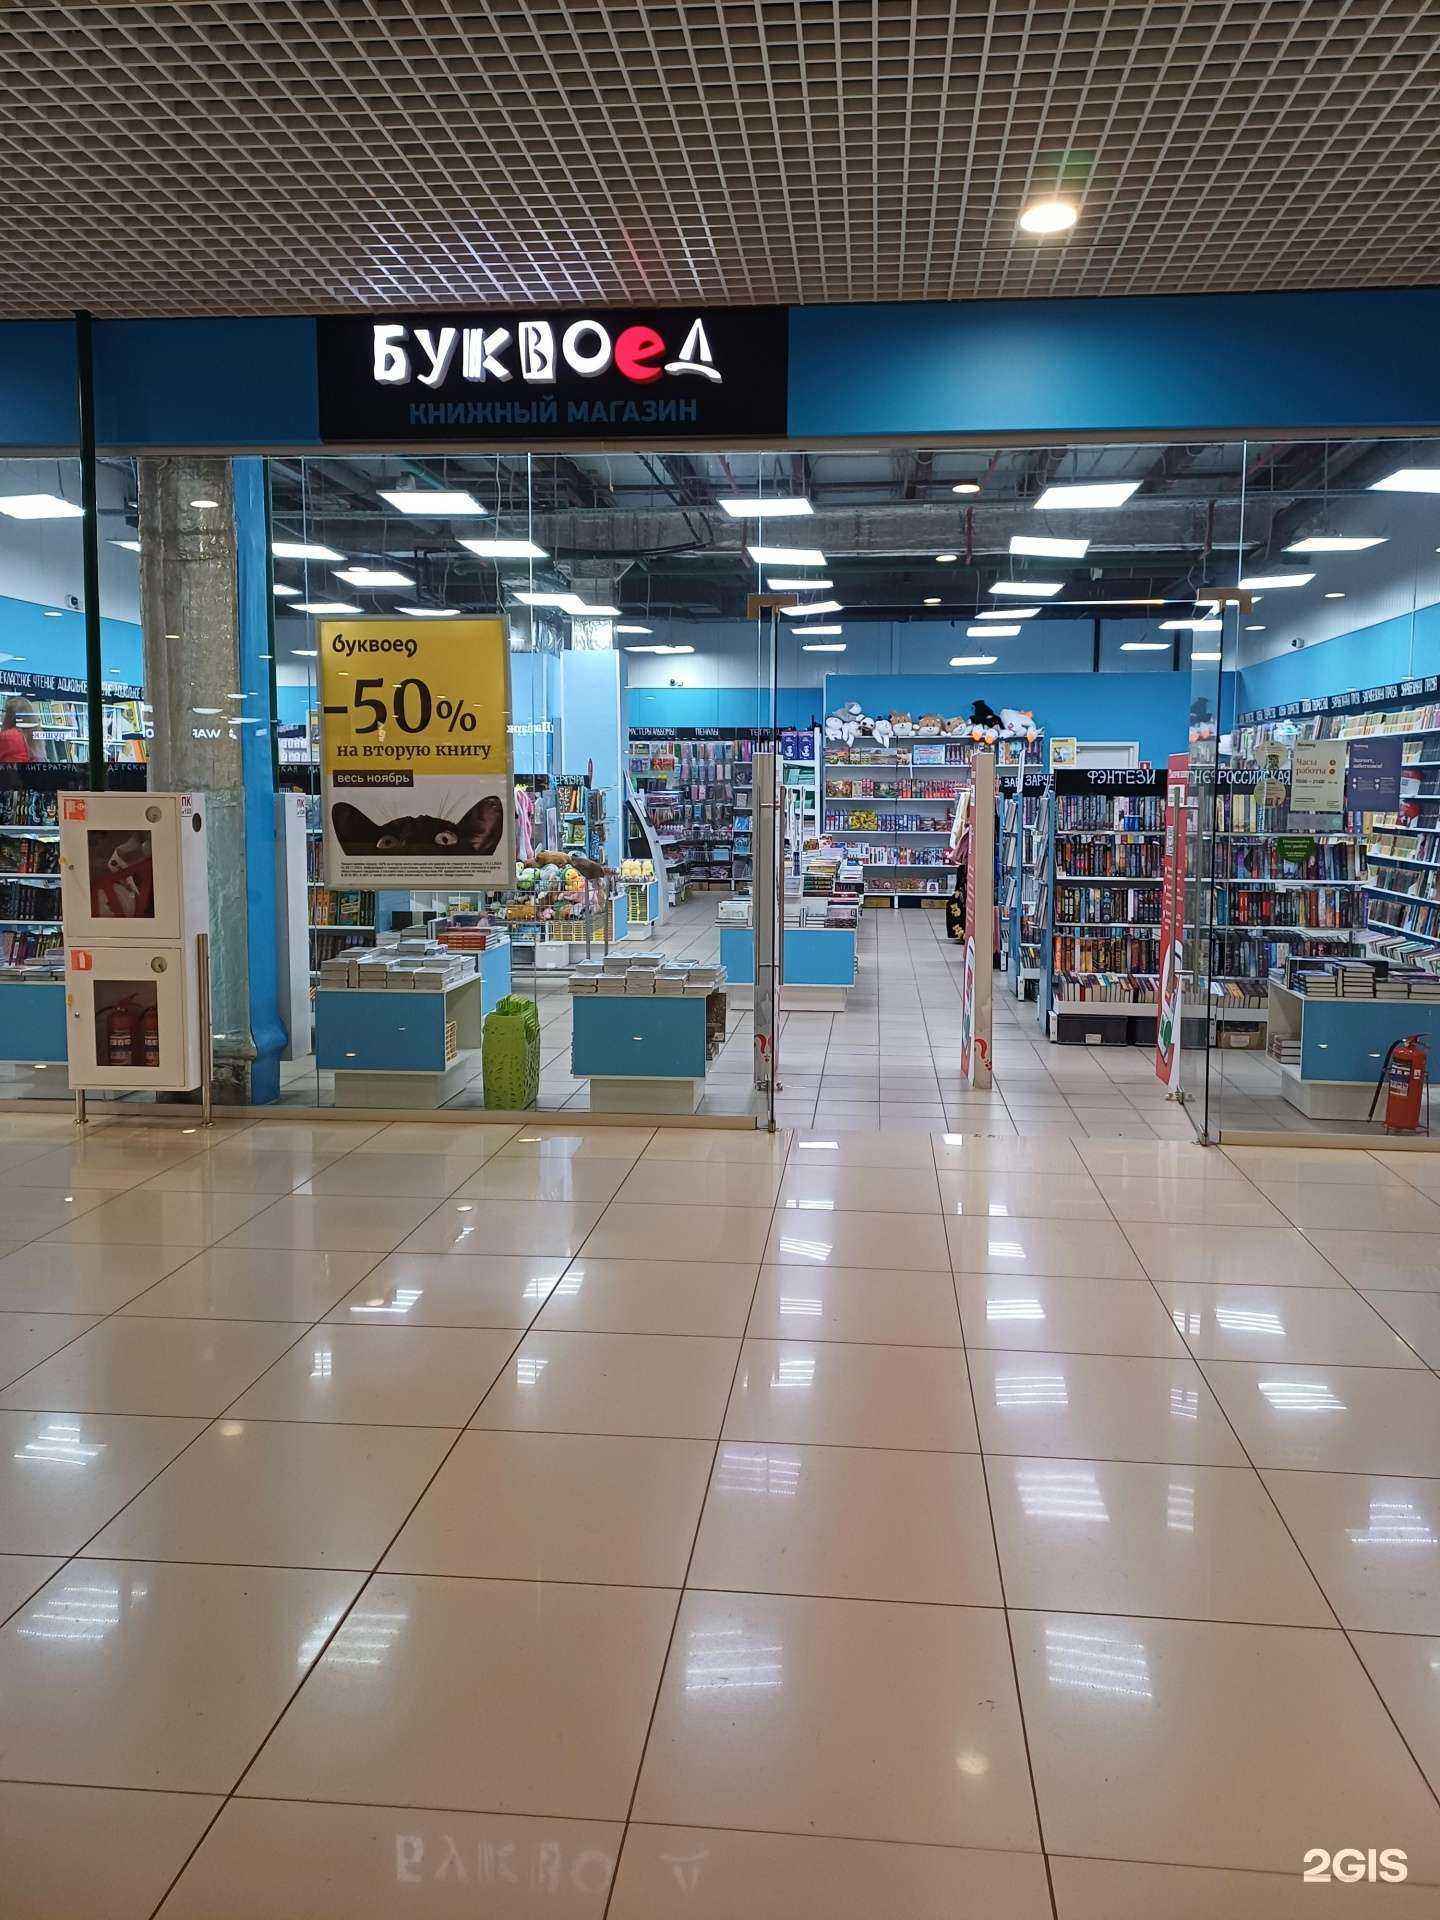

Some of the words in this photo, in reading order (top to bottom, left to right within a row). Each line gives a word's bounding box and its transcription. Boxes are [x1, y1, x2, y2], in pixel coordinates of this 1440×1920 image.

[409, 394, 558, 425] КНИЖНЫЙ
[567, 398, 697, 424] МАГАЗИН
[332, 634, 418, 657] буквоед
[336, 744, 357, 757] на
[363, 743, 430, 760] вторую
[436, 743, 491, 761] книгу
[337, 774, 364, 784] весь
[367, 773, 410, 784] ноябрь
[1087, 769, 1156, 785] ФЭНТЕЗИ
[1216, 769, 1291, 786] РОССИЙСКАЯ
[181, 796, 192, 807] ПК
